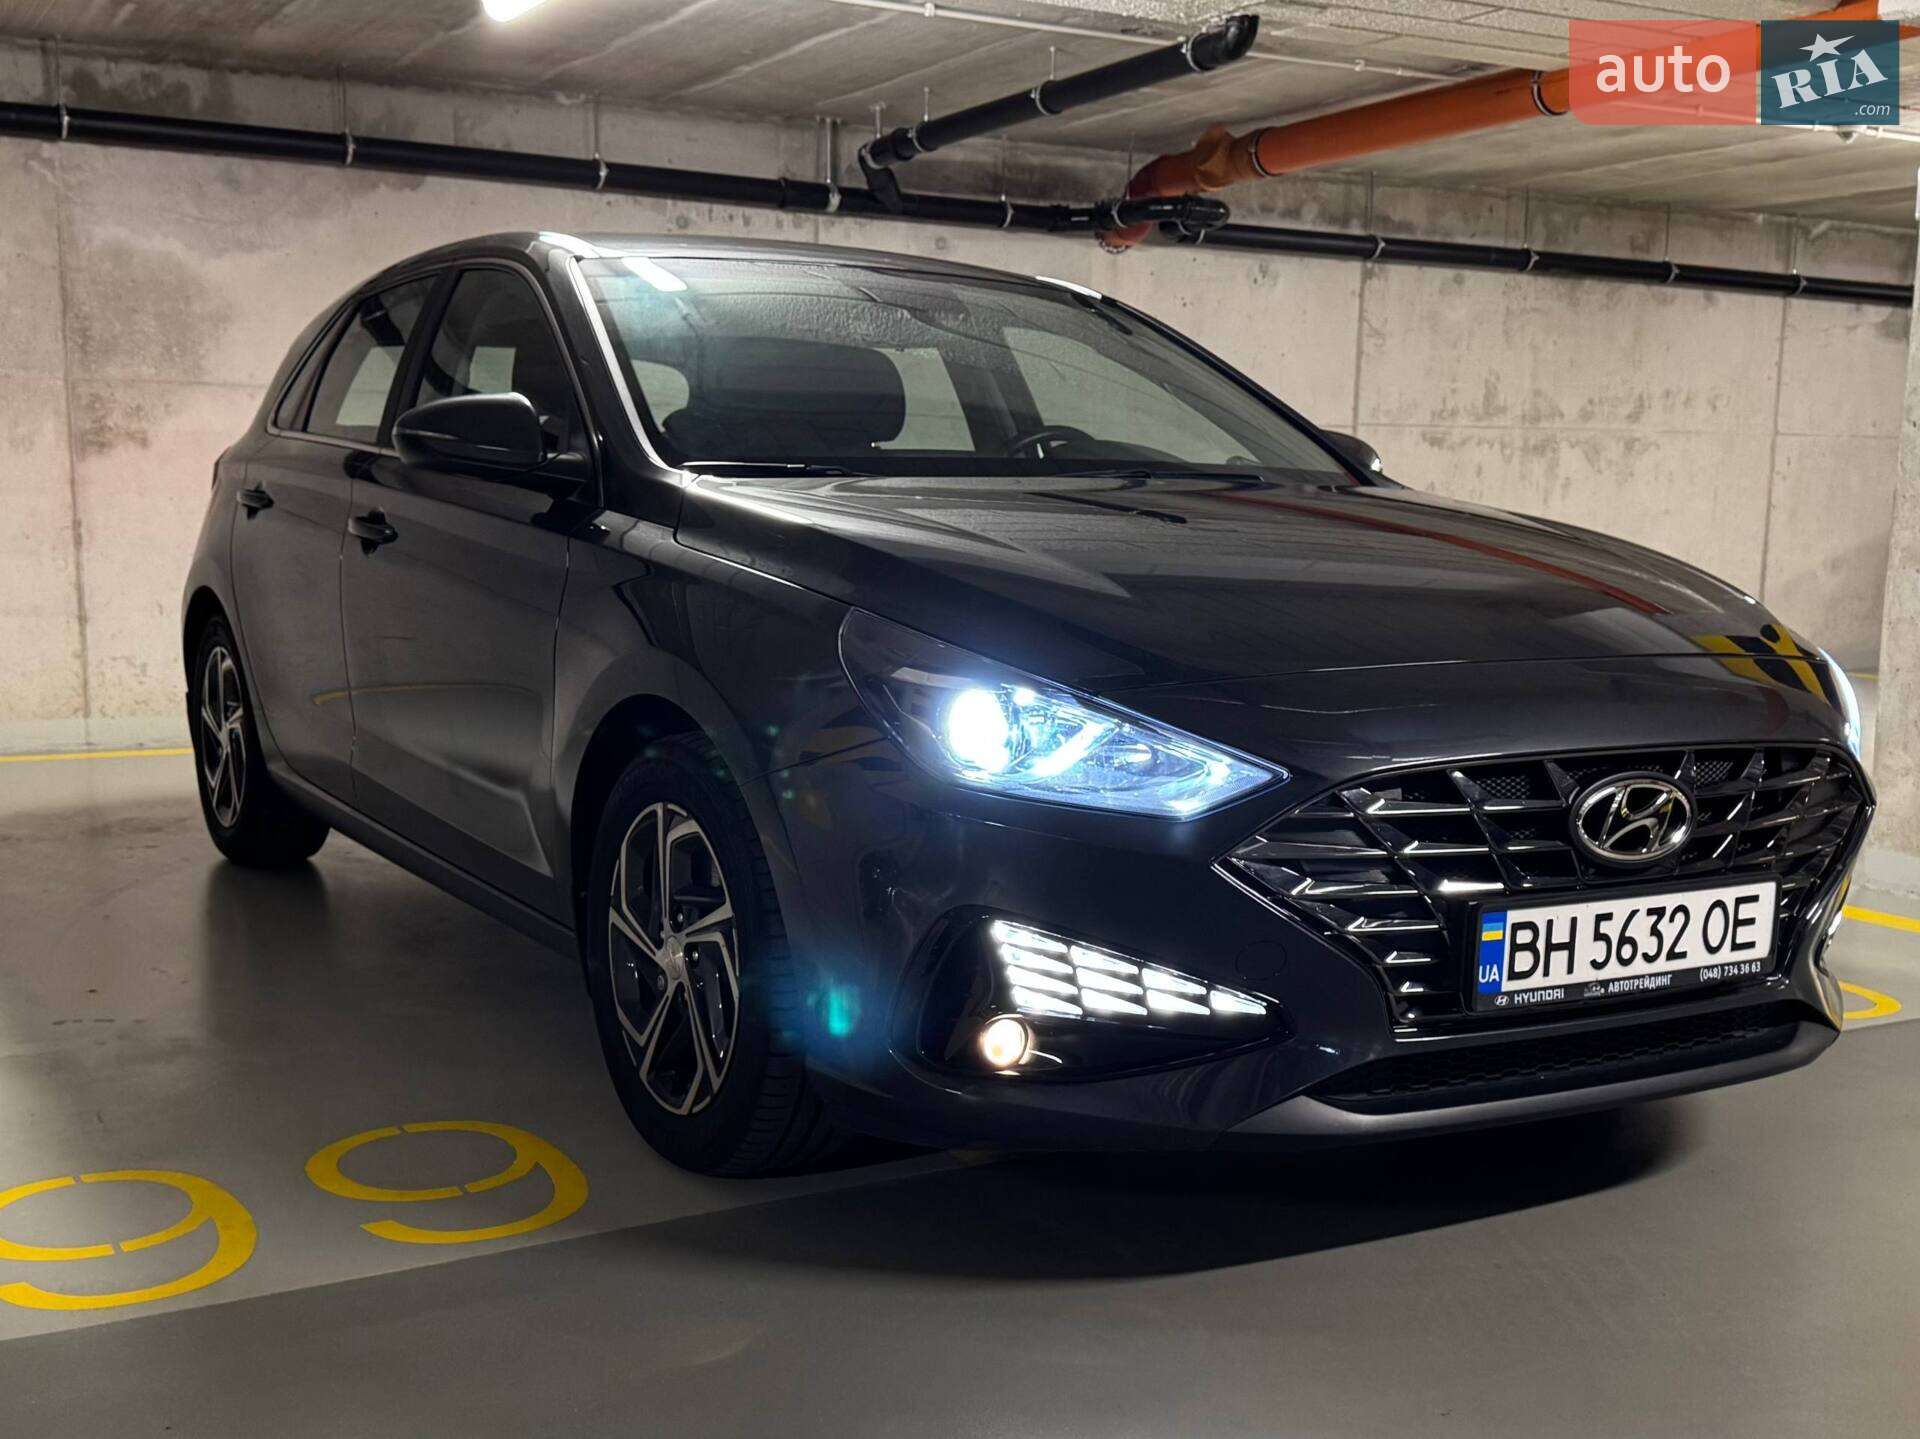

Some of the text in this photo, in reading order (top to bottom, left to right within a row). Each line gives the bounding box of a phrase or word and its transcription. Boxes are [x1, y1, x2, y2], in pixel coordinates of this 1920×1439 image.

[1507, 893, 1760, 982] BH 5632 OE
[1478, 963, 1500, 983] UA
[1699, 967, 1722, 982] (048)
[1608, 974, 1673, 993] АВТОТРЕЙДИНГ
[1514, 988, 1565, 1005] HYUNDAI
